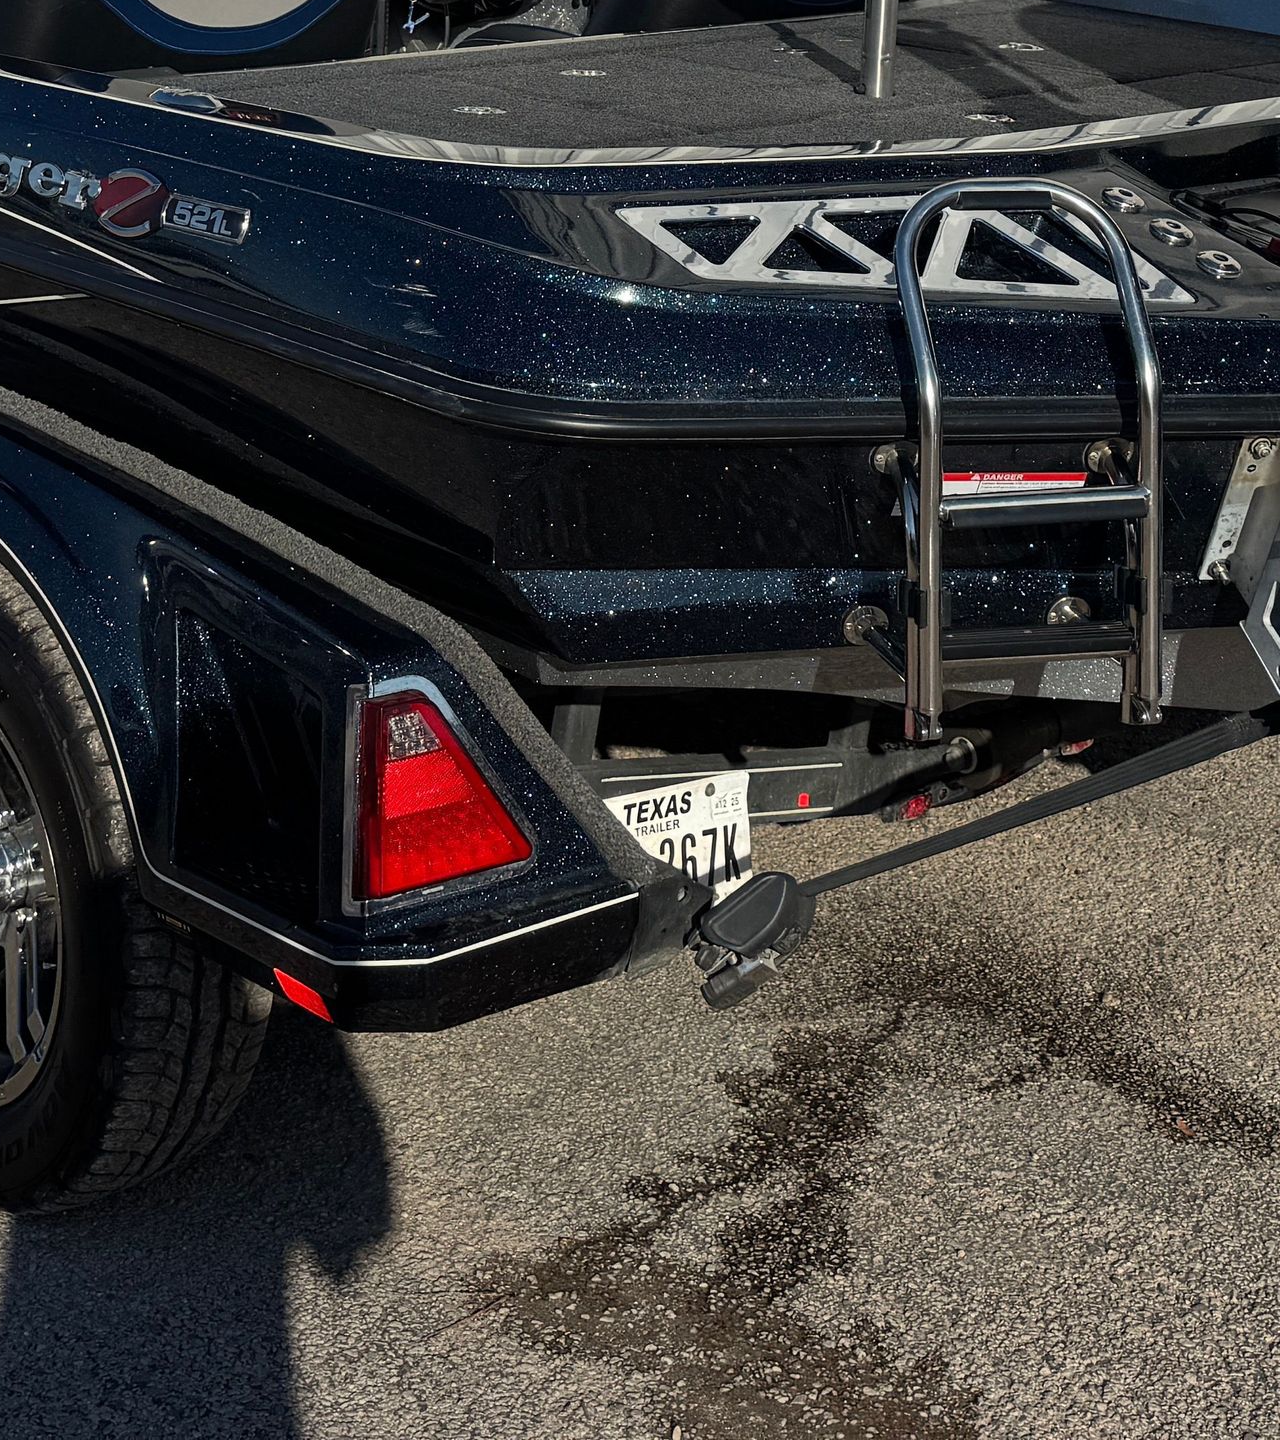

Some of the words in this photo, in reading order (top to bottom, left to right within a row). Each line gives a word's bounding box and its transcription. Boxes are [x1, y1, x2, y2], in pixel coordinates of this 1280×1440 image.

[983, 473, 1024, 481] DANGER
[623, 791, 692, 826] TEXAS
[634, 819, 680, 838] TRAILER
